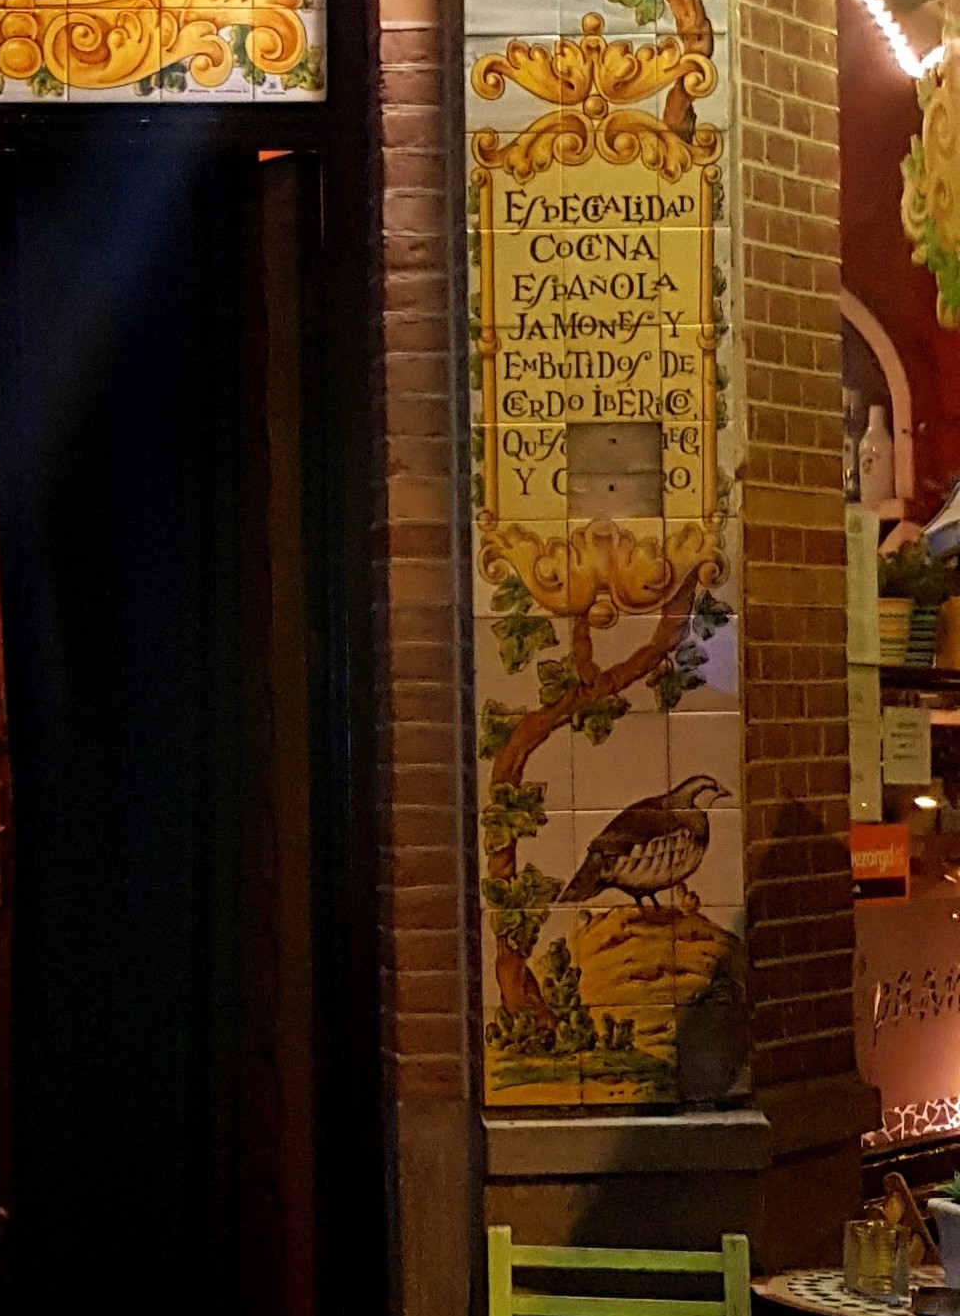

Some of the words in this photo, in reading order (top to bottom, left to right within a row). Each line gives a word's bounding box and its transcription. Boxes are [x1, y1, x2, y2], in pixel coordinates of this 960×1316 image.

[504, 189, 695, 235] ESPECIALIDAD
[529, 233, 658, 263] COCINA
[511, 272, 678, 309] ESPAÑOLA
[662, 311, 685, 338] Y
[503, 350, 652, 383] EMBUTIDOS
[661, 351, 695, 377] DE
[502, 388, 585, 420] CERDO
[513, 467, 537, 495] Y
